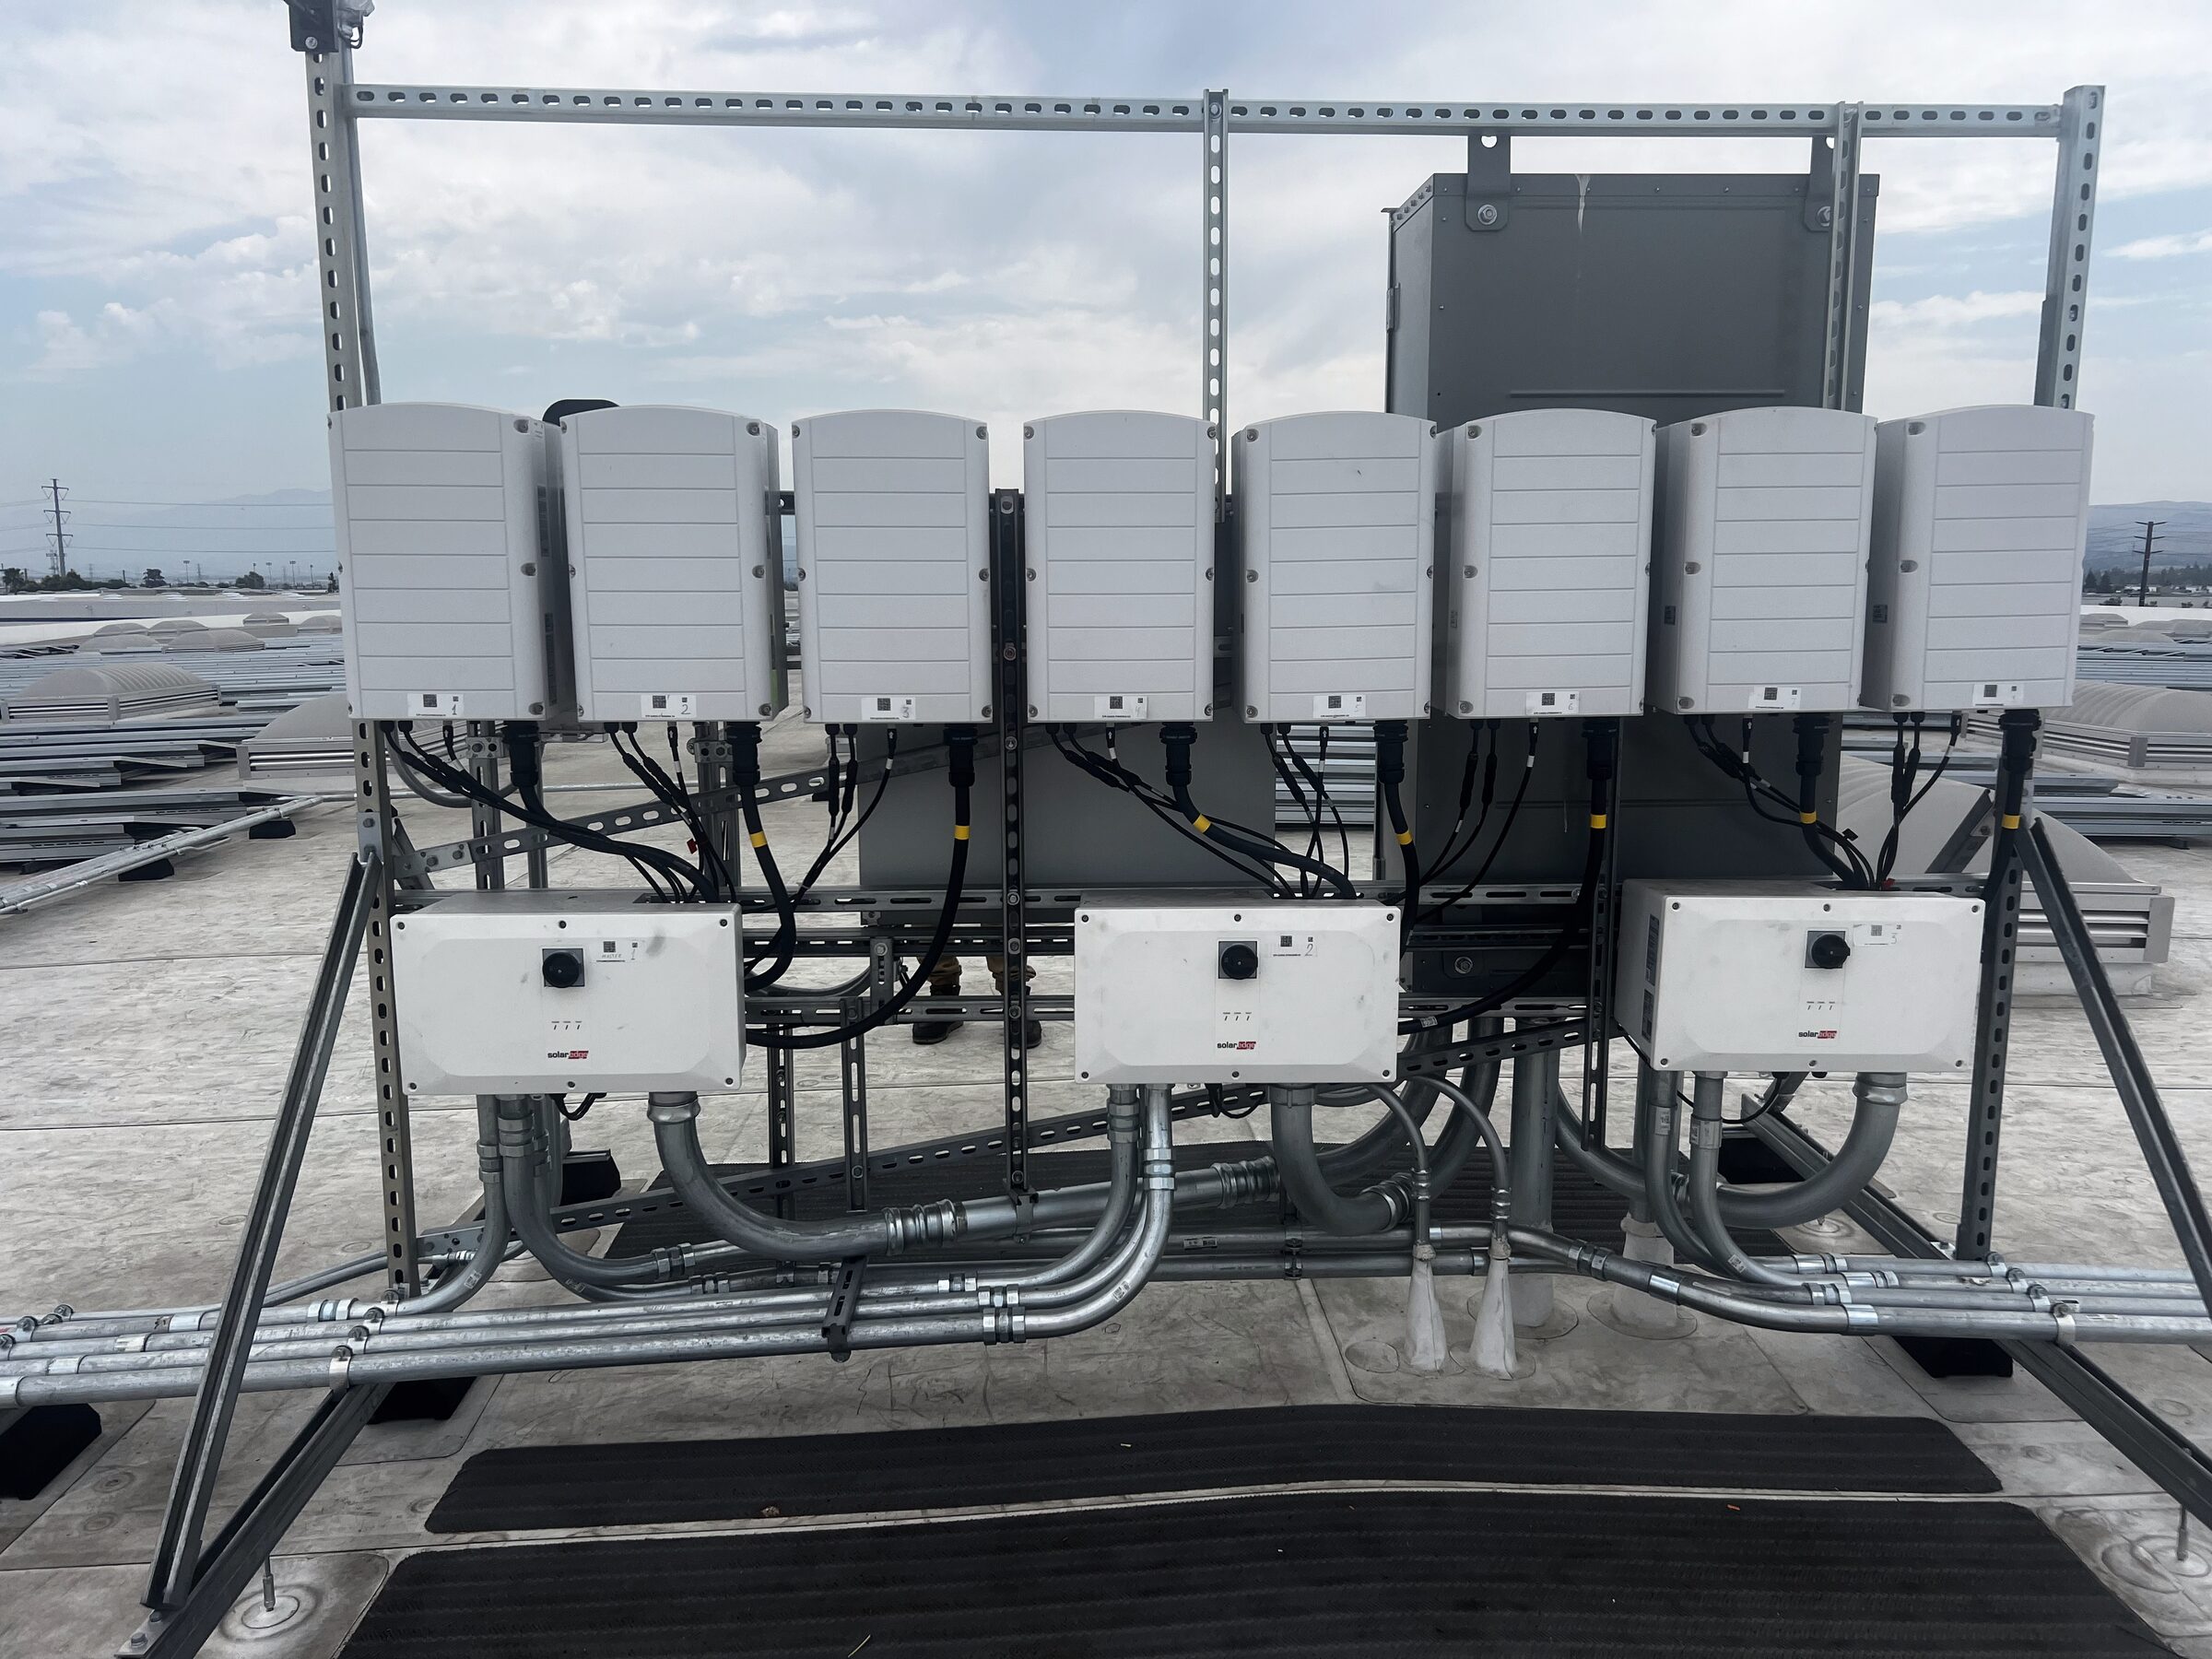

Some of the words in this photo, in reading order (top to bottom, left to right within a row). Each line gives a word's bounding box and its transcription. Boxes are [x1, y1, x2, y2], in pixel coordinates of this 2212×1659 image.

[452, 704, 457, 715] 1
[680, 703, 691, 715] 2
[901, 706, 910, 719] 3
[1304, 943, 1313, 957] 2
